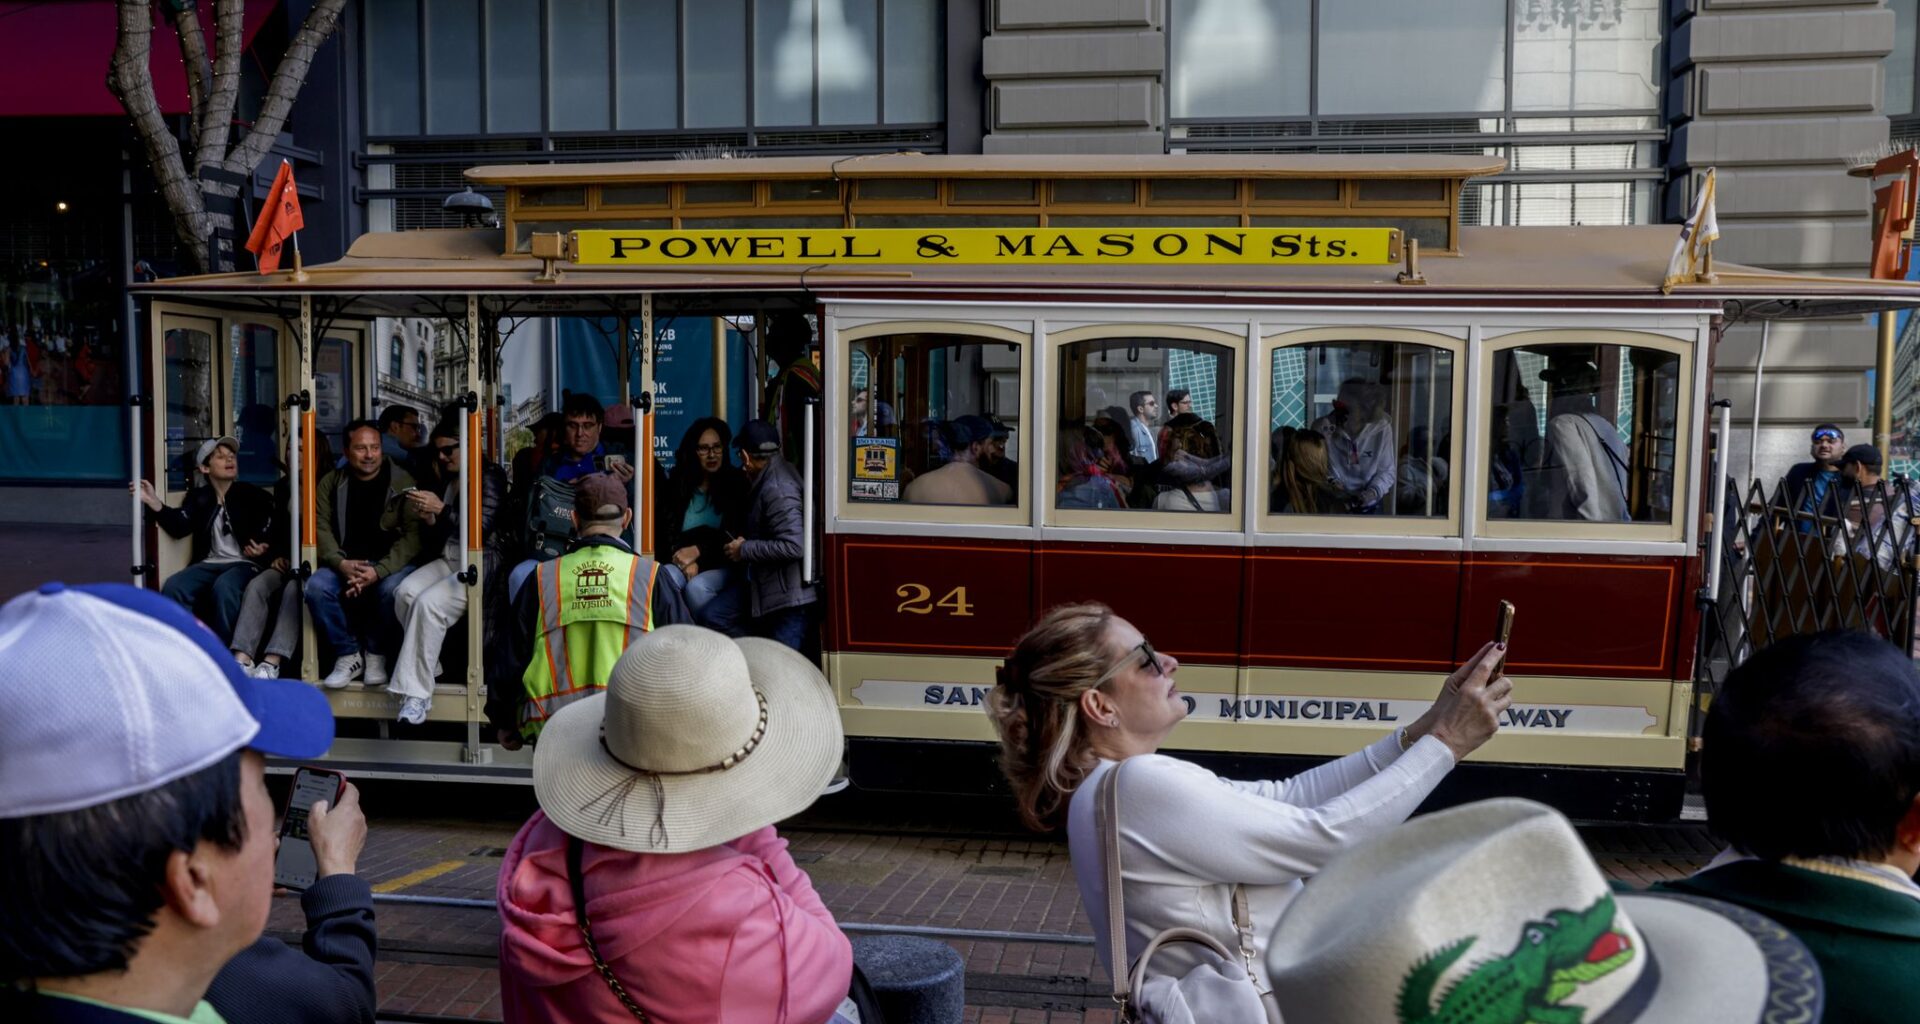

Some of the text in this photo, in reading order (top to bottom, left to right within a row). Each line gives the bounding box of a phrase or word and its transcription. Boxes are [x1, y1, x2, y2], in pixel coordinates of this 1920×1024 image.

[610, 233, 1359, 259] POWELL & MASON Sts.
[571, 560, 615, 576] CABLE CAR
[571, 600, 613, 610] DIVISION
[896, 583, 974, 616] 24
[924, 684, 991, 706] SAN
[1219, 698, 1399, 721] MUNICIPAL
